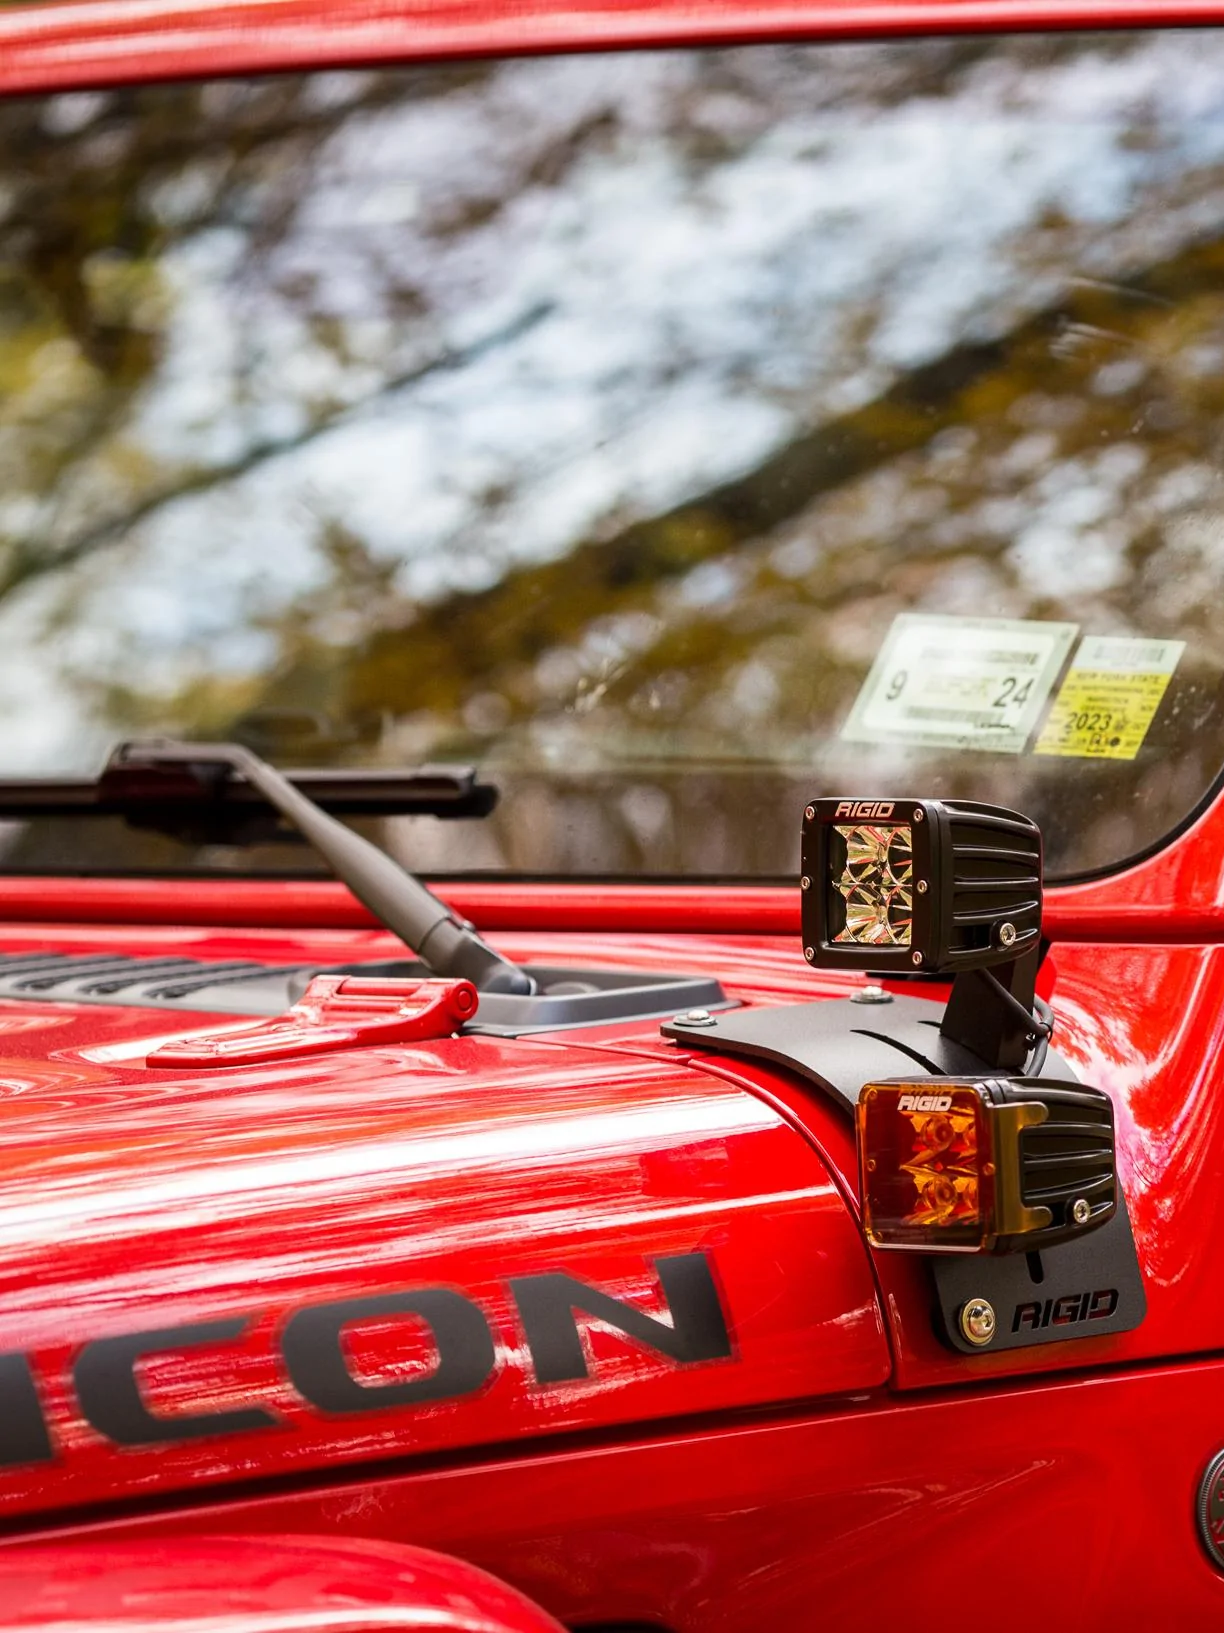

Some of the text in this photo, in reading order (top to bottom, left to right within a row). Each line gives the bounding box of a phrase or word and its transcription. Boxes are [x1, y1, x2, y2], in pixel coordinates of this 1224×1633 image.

[886, 669, 909, 702] 9
[991, 676, 1036, 710] 24
[1064, 711, 1113, 731] 2023
[834, 801, 896, 818] RIGID
[897, 1095, 953, 1112] RIGID
[1011, 1288, 1119, 1333] RIGID
